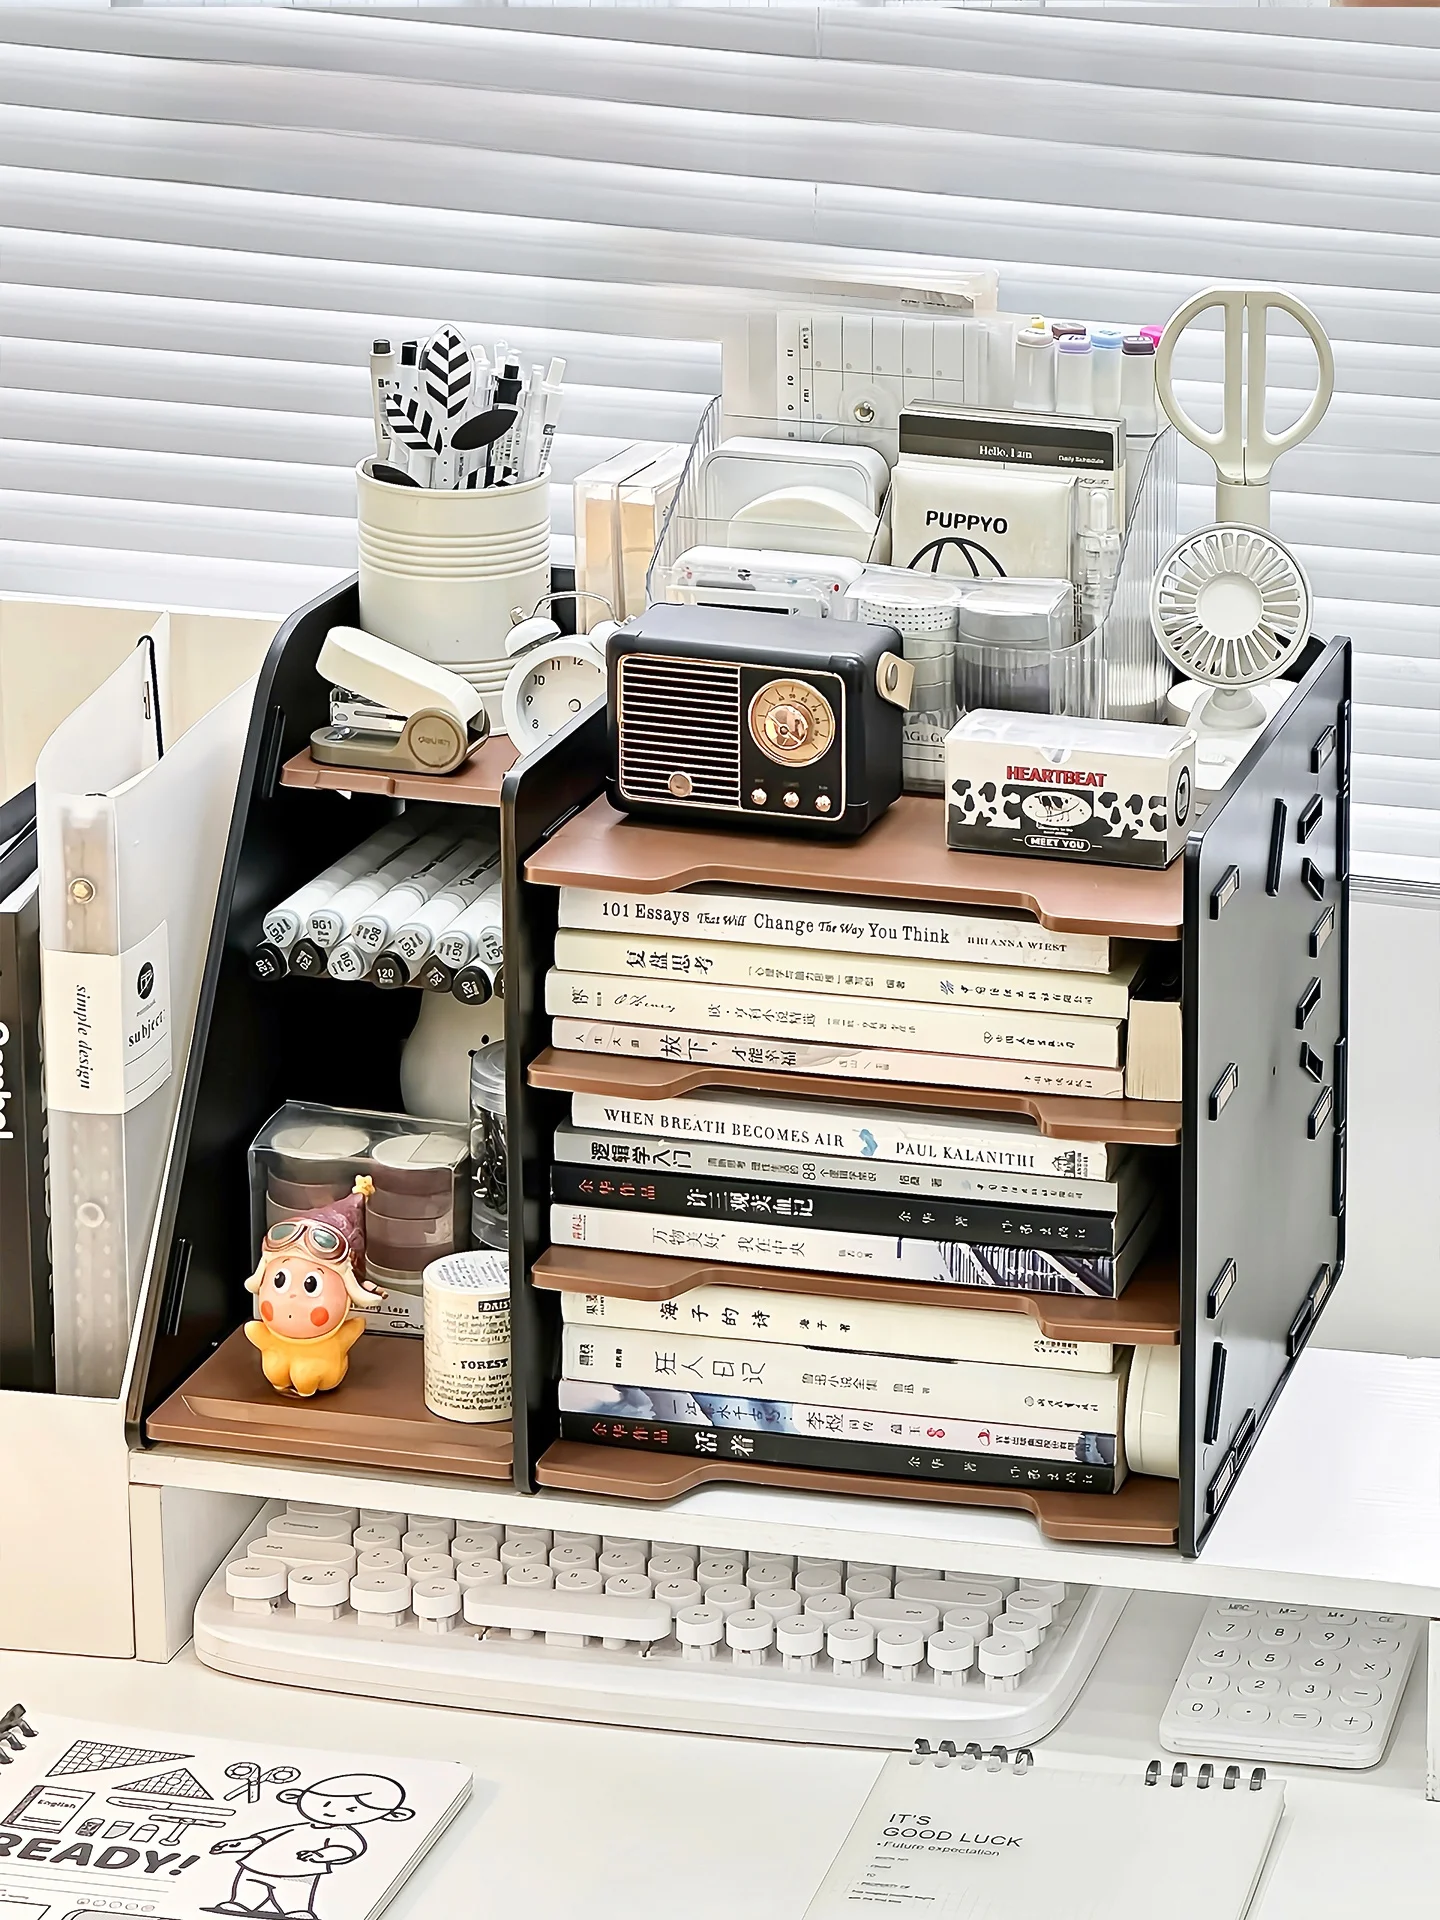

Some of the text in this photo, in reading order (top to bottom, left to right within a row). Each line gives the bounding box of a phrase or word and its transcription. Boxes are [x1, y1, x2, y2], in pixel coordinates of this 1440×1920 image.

[925, 509, 1009, 534] PUPPYO
[550, 659, 561, 671] 11
[572, 656, 584, 666] 12
[533, 674, 546, 686] 10
[525, 695, 534, 707] 9
[531, 718, 540, 729] 8
[1006, 765, 1108, 787] HEARTBEAT
[1061, 839, 1085, 850] YOU
[311, 919, 332, 930] BG1
[602, 901, 630, 917] 101
[635, 903, 690, 924] Essays
[753, 913, 814, 935] Change
[839, 923, 864, 938] Way
[868, 922, 898, 940] You
[902, 925, 951, 944] Think
[366, 926, 382, 948] BG1
[397, 936, 416, 958] BG1
[340, 951, 356, 973] BG1
[376, 968, 394, 978] 120
[73, 984, 94, 1090] simple design
[603, 1107, 1036, 1169] WHEN BREATH BECOMES AIR PAUL KALANITHI
[590, 1140, 692, 1169] 逻辑学入门
[578, 1179, 656, 1200] 余华作品
[686, 1187, 815, 1217] 许三观卖血记
[659, 1300, 771, 1329] 海子的诗
[654, 1350, 767, 1385] 狂人日记
[592, 1421, 669, 1445] 余华作品
[693, 1430, 756, 1458] 活着
[1225, 1623, 1335, 1642] 7 8 9
[1214, 1649, 1325, 1667] 4 5 6
[1206, 1675, 1315, 1694] 1 2 3
[1192, 1702, 1204, 1712] 0
[37, 1799, 77, 1810] English
[889, 1813, 932, 1826] IT'S
[882, 1826, 1024, 1848] GOOD LUCK
[927, 1844, 1001, 1857] expectation
